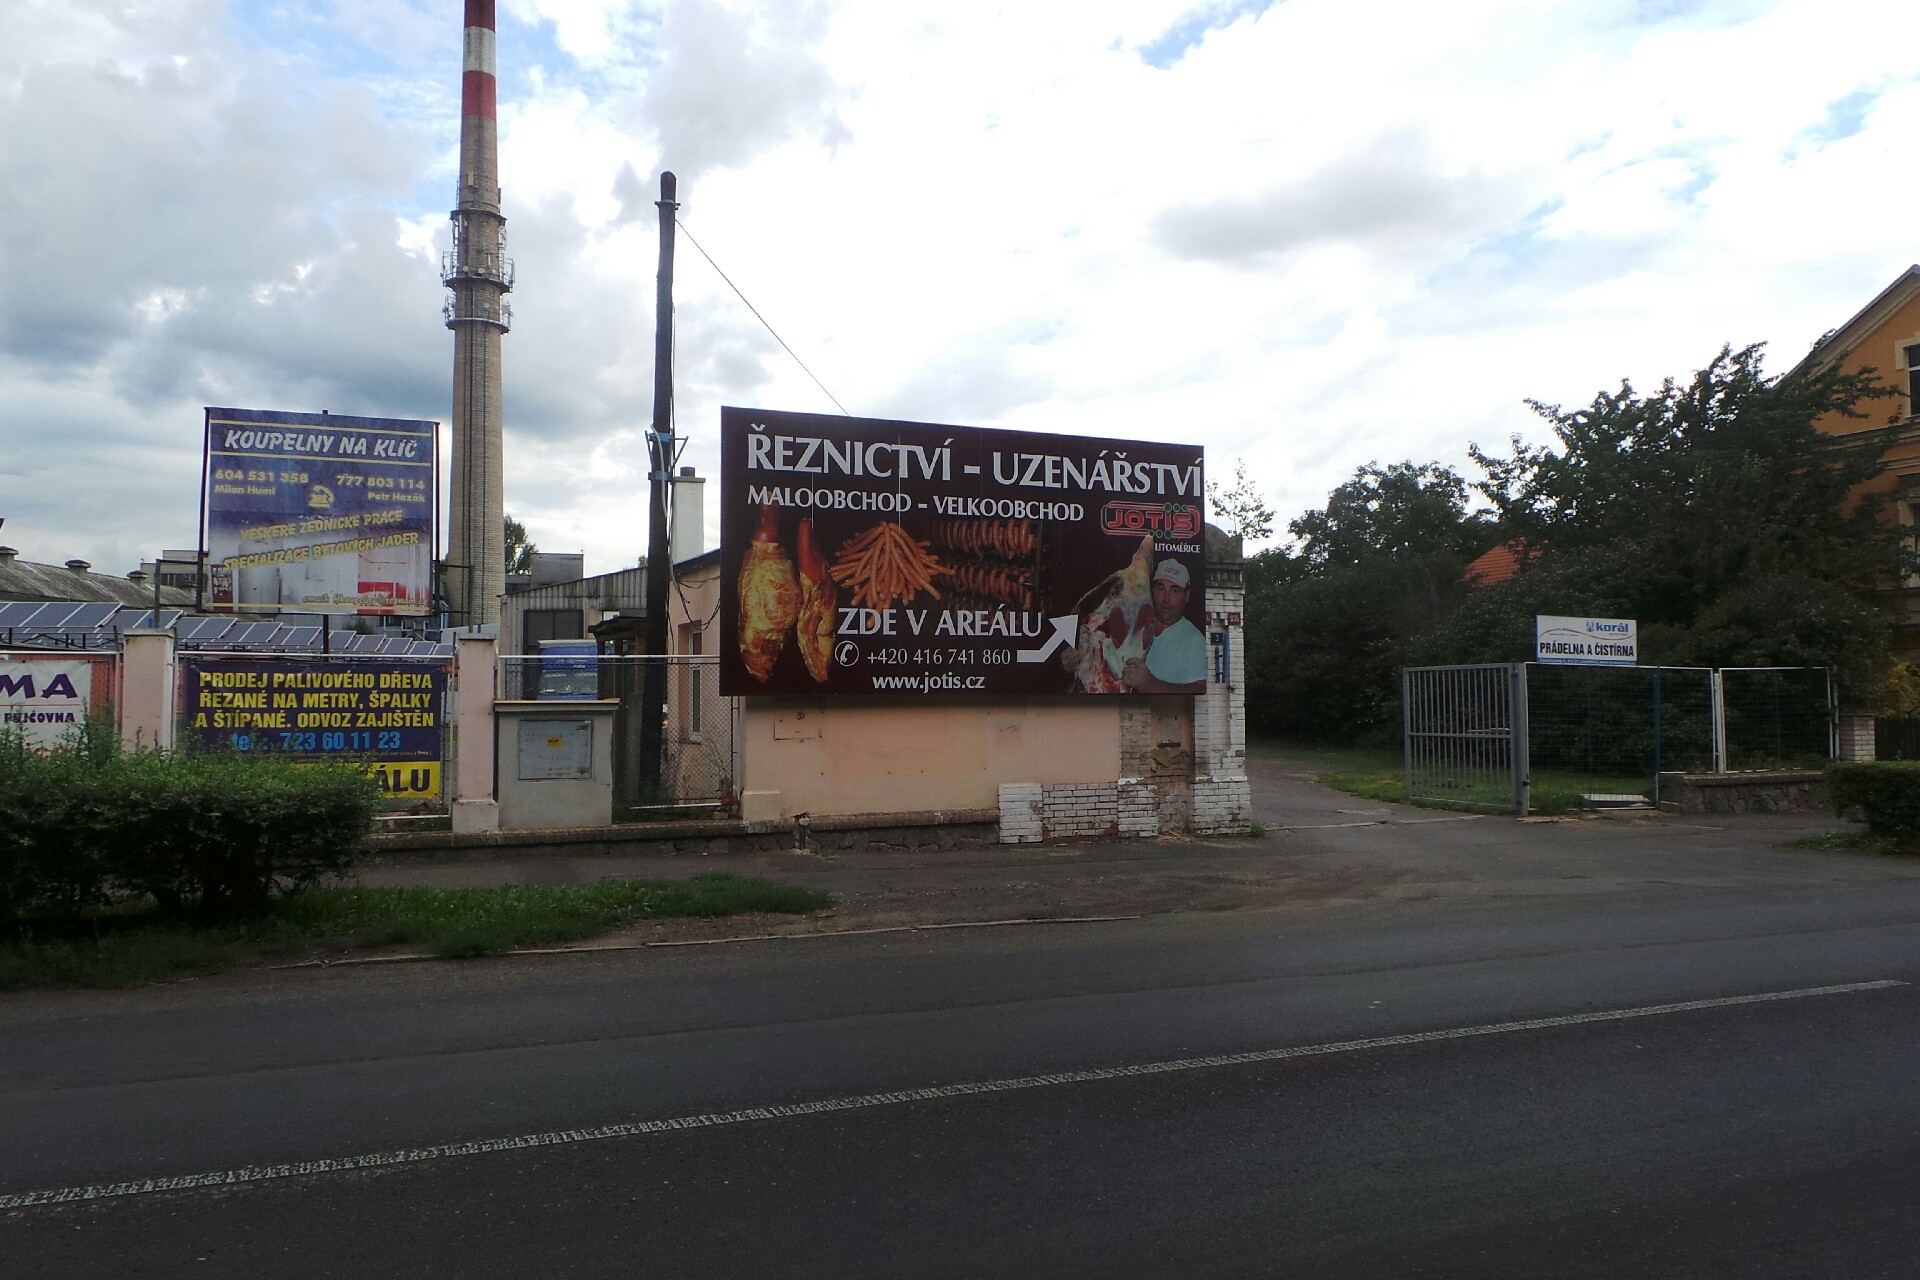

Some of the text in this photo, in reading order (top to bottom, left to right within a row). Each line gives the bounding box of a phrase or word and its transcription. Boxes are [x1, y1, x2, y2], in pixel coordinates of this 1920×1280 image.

[224, 430, 418, 458] KOUPELNY NA KLÍČ
[747, 424, 954, 482] ŘEZNICTVÍ
[993, 449, 1203, 497] UZENÁŘSTVÍ
[215, 469, 309, 484] 604 531 358
[336, 474, 425, 490] 777 803 114
[215, 484, 244, 495] Milan
[368, 491, 390, 501] Petr
[747, 485, 912, 513] MALOOBCHOD
[933, 496, 1085, 522] VELKOOBCHOD
[1108, 509, 1193, 531] JOTIS
[223, 547, 310, 571] SPECIALIZACE
[378, 531, 420, 548] JADER
[837, 603, 1042, 637] ZDE V AREÁLU
[1596, 622, 1629, 632] korál
[867, 648, 1011, 665] +420 416 741 860
[1540, 640, 1635, 657] PRÁDELNA A ČISTÍRNA
[199, 670, 433, 689] PRODEJ PALIVOVÉHO DŘEVA
[872, 671, 986, 694] www.jotis.cz
[199, 690, 431, 710] ŘEZANÉ NA METRY, ŠPALKY
[195, 710, 434, 728] A ŠTÍPANÉ. ODVOZ ZAJIŠTĚN
[280, 731, 316, 750] 723
[322, 731, 345, 750] 60
[351, 732, 371, 750] 11
[378, 731, 400, 750] 23
[374, 764, 431, 792] ÁLU
